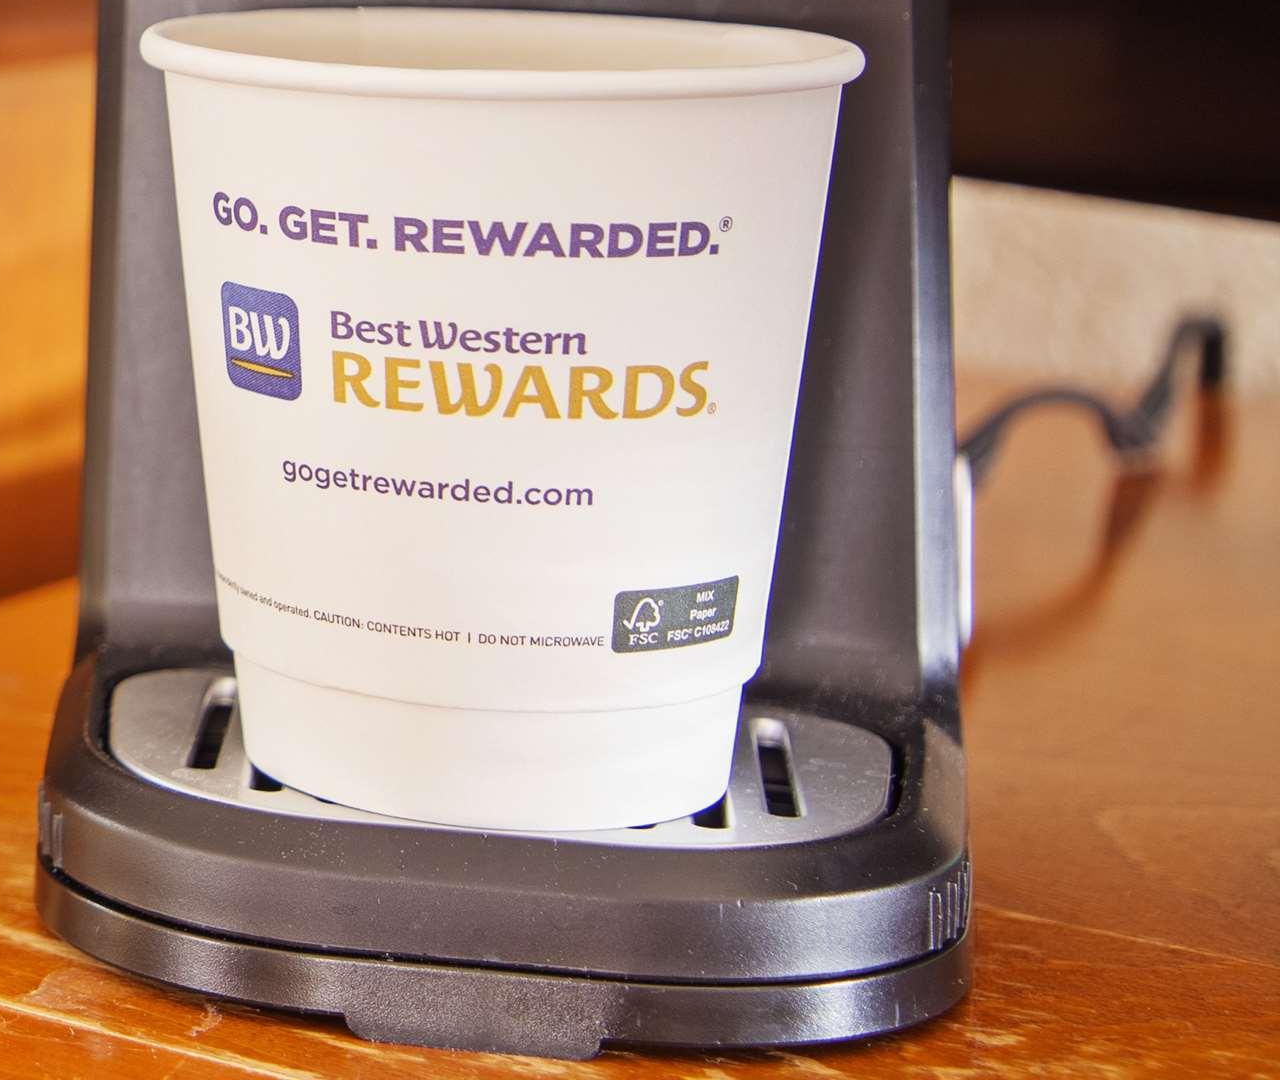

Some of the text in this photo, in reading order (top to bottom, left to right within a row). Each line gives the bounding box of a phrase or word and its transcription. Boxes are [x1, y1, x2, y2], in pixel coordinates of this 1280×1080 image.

[213, 191, 268, 236] GO.
[278, 205, 378, 250] GET.
[228, 306, 291, 361] BW
[330, 310, 588, 356] Best Western
[282, 460, 595, 506] gogetrewarded.com
[688, 607, 718, 621] Paper
[695, 590, 715, 604] MIX
[313, 609, 365, 630] CAUTION:
[366, 620, 432, 640] CONTENTS
[434, 629, 461, 642] HOT
[478, 633, 497, 645] DO
[500, 635, 526, 646] NOT
[530, 635, 606, 648] MICROWAVE
[627, 631, 659, 646] FSC
